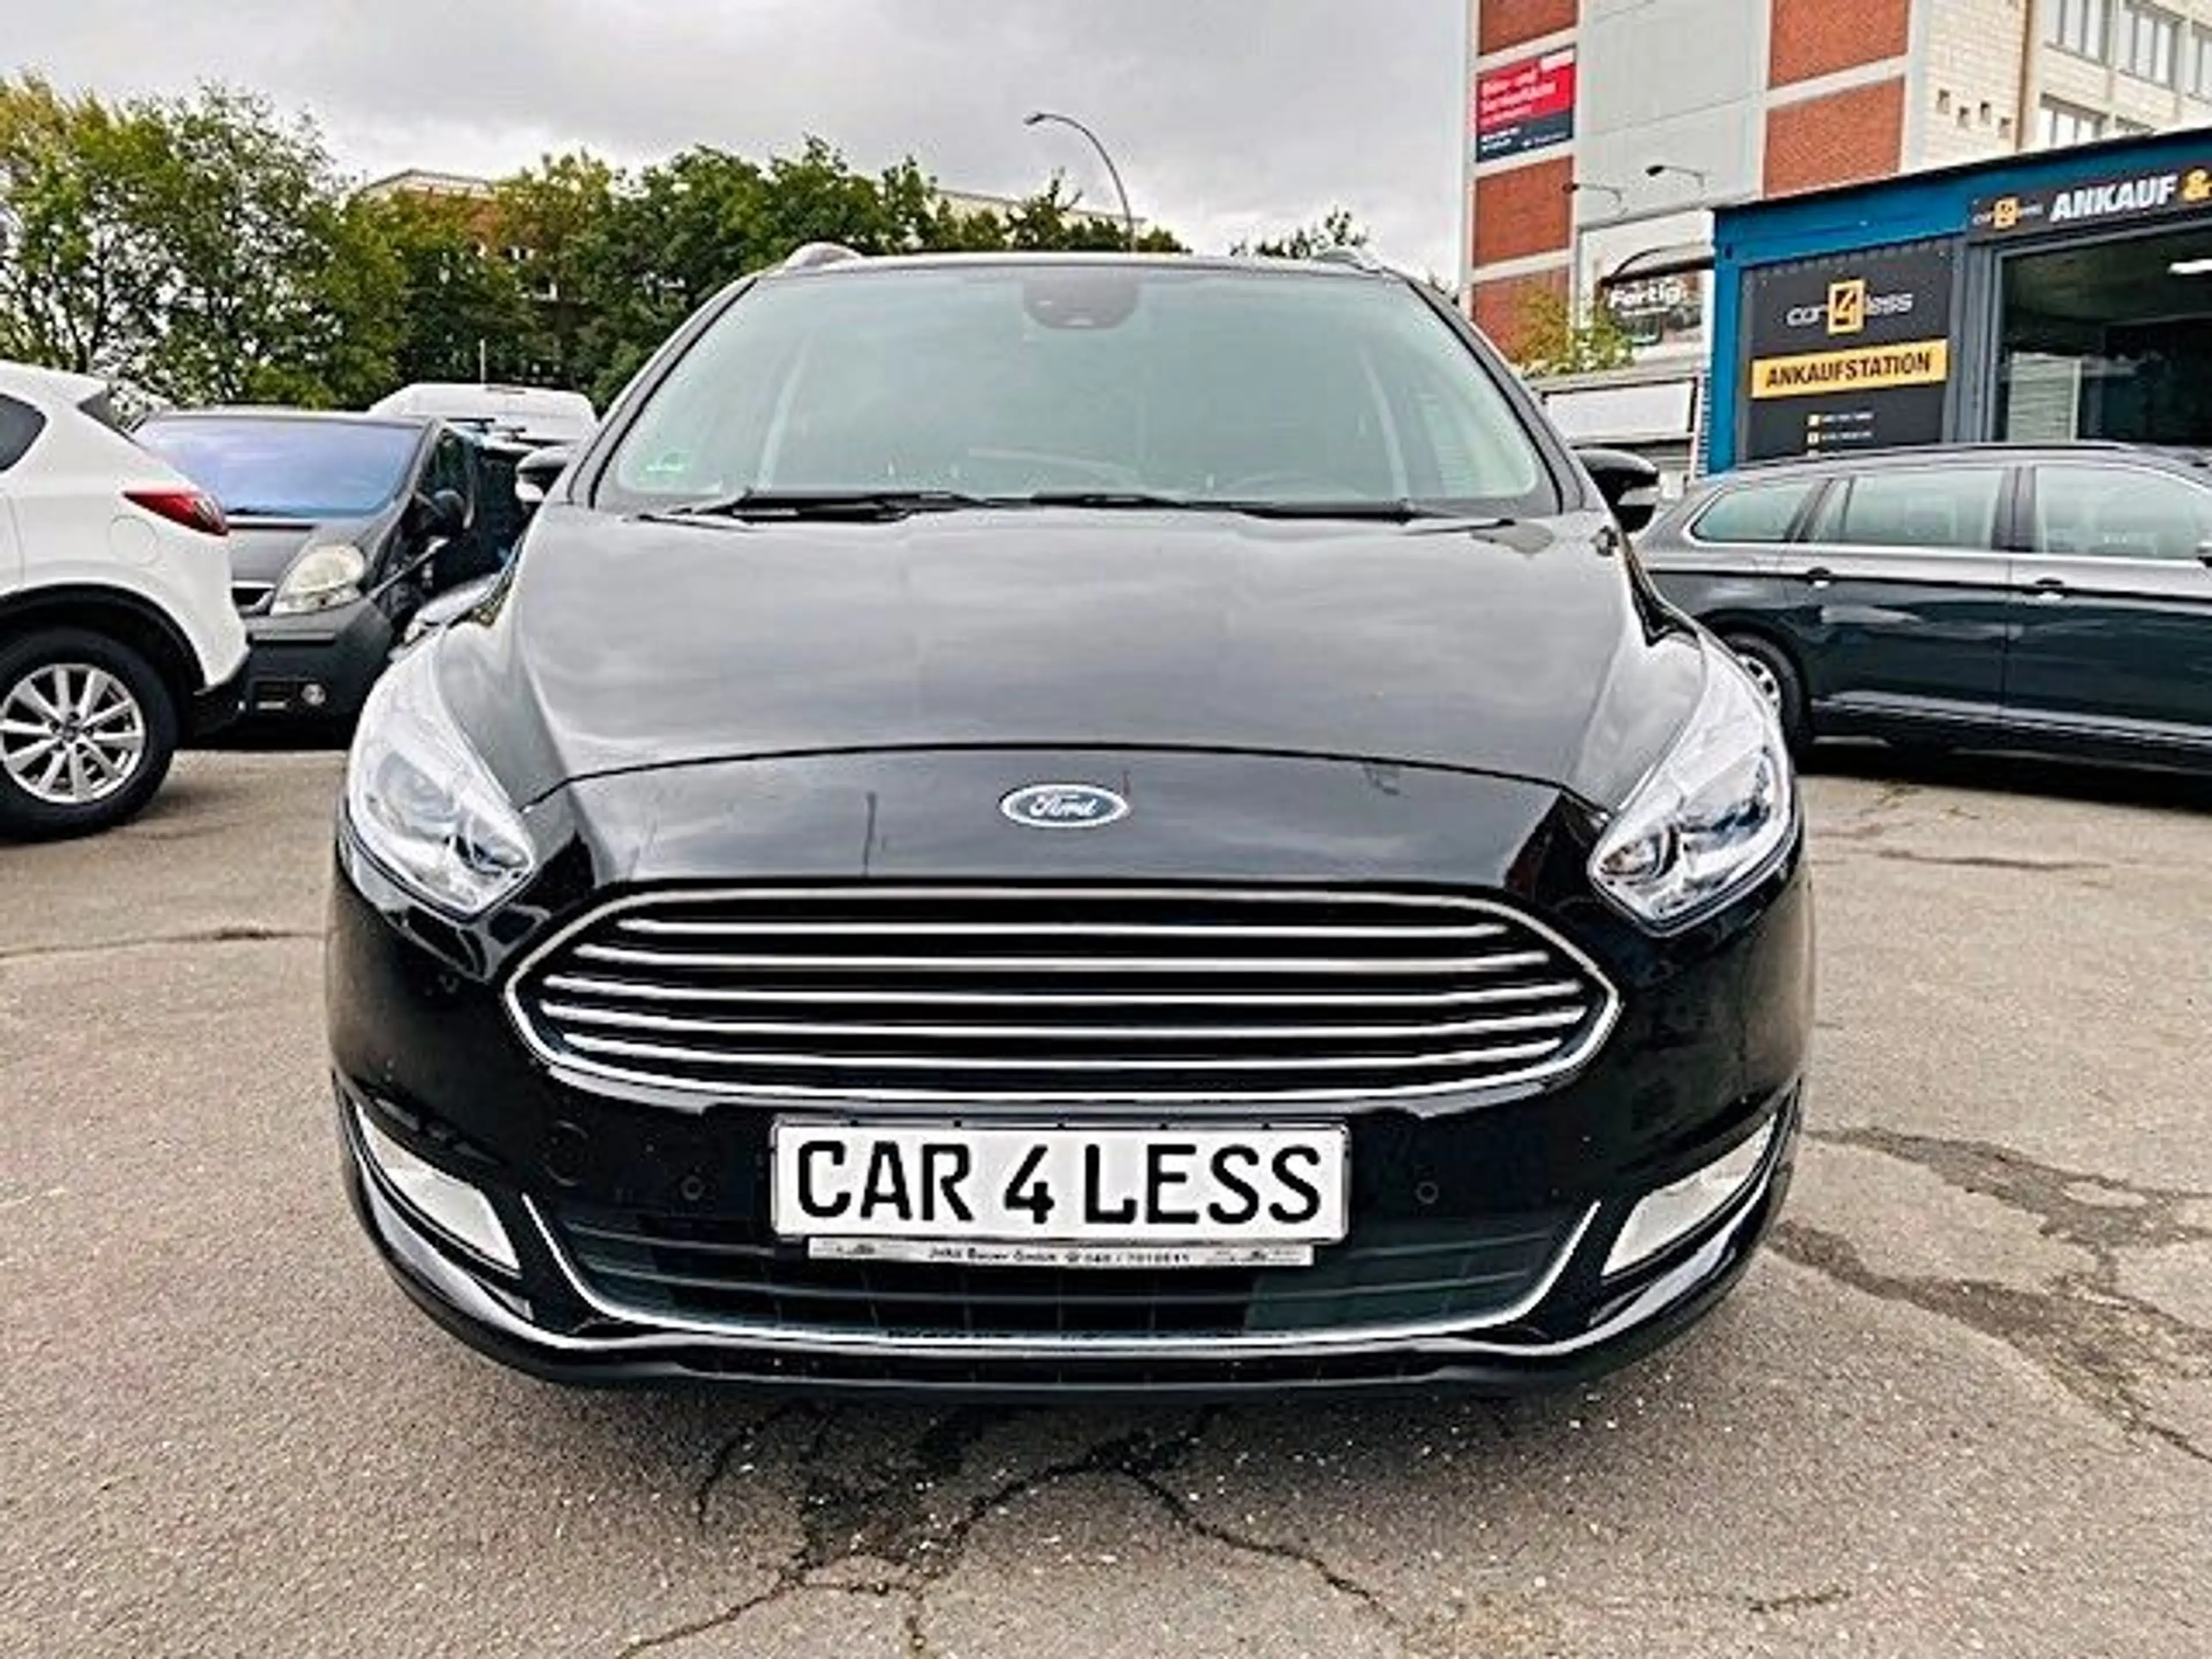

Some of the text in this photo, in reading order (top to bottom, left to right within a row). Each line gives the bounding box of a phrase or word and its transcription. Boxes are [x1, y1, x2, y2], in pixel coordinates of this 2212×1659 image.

[2048, 175, 2179, 223] ANKAUF
[1766, 353, 1930, 388] ANKAUFSTATION
[1029, 794, 1100, 817] Ford
[797, 1140, 1321, 1225] CAR 4 LESS
